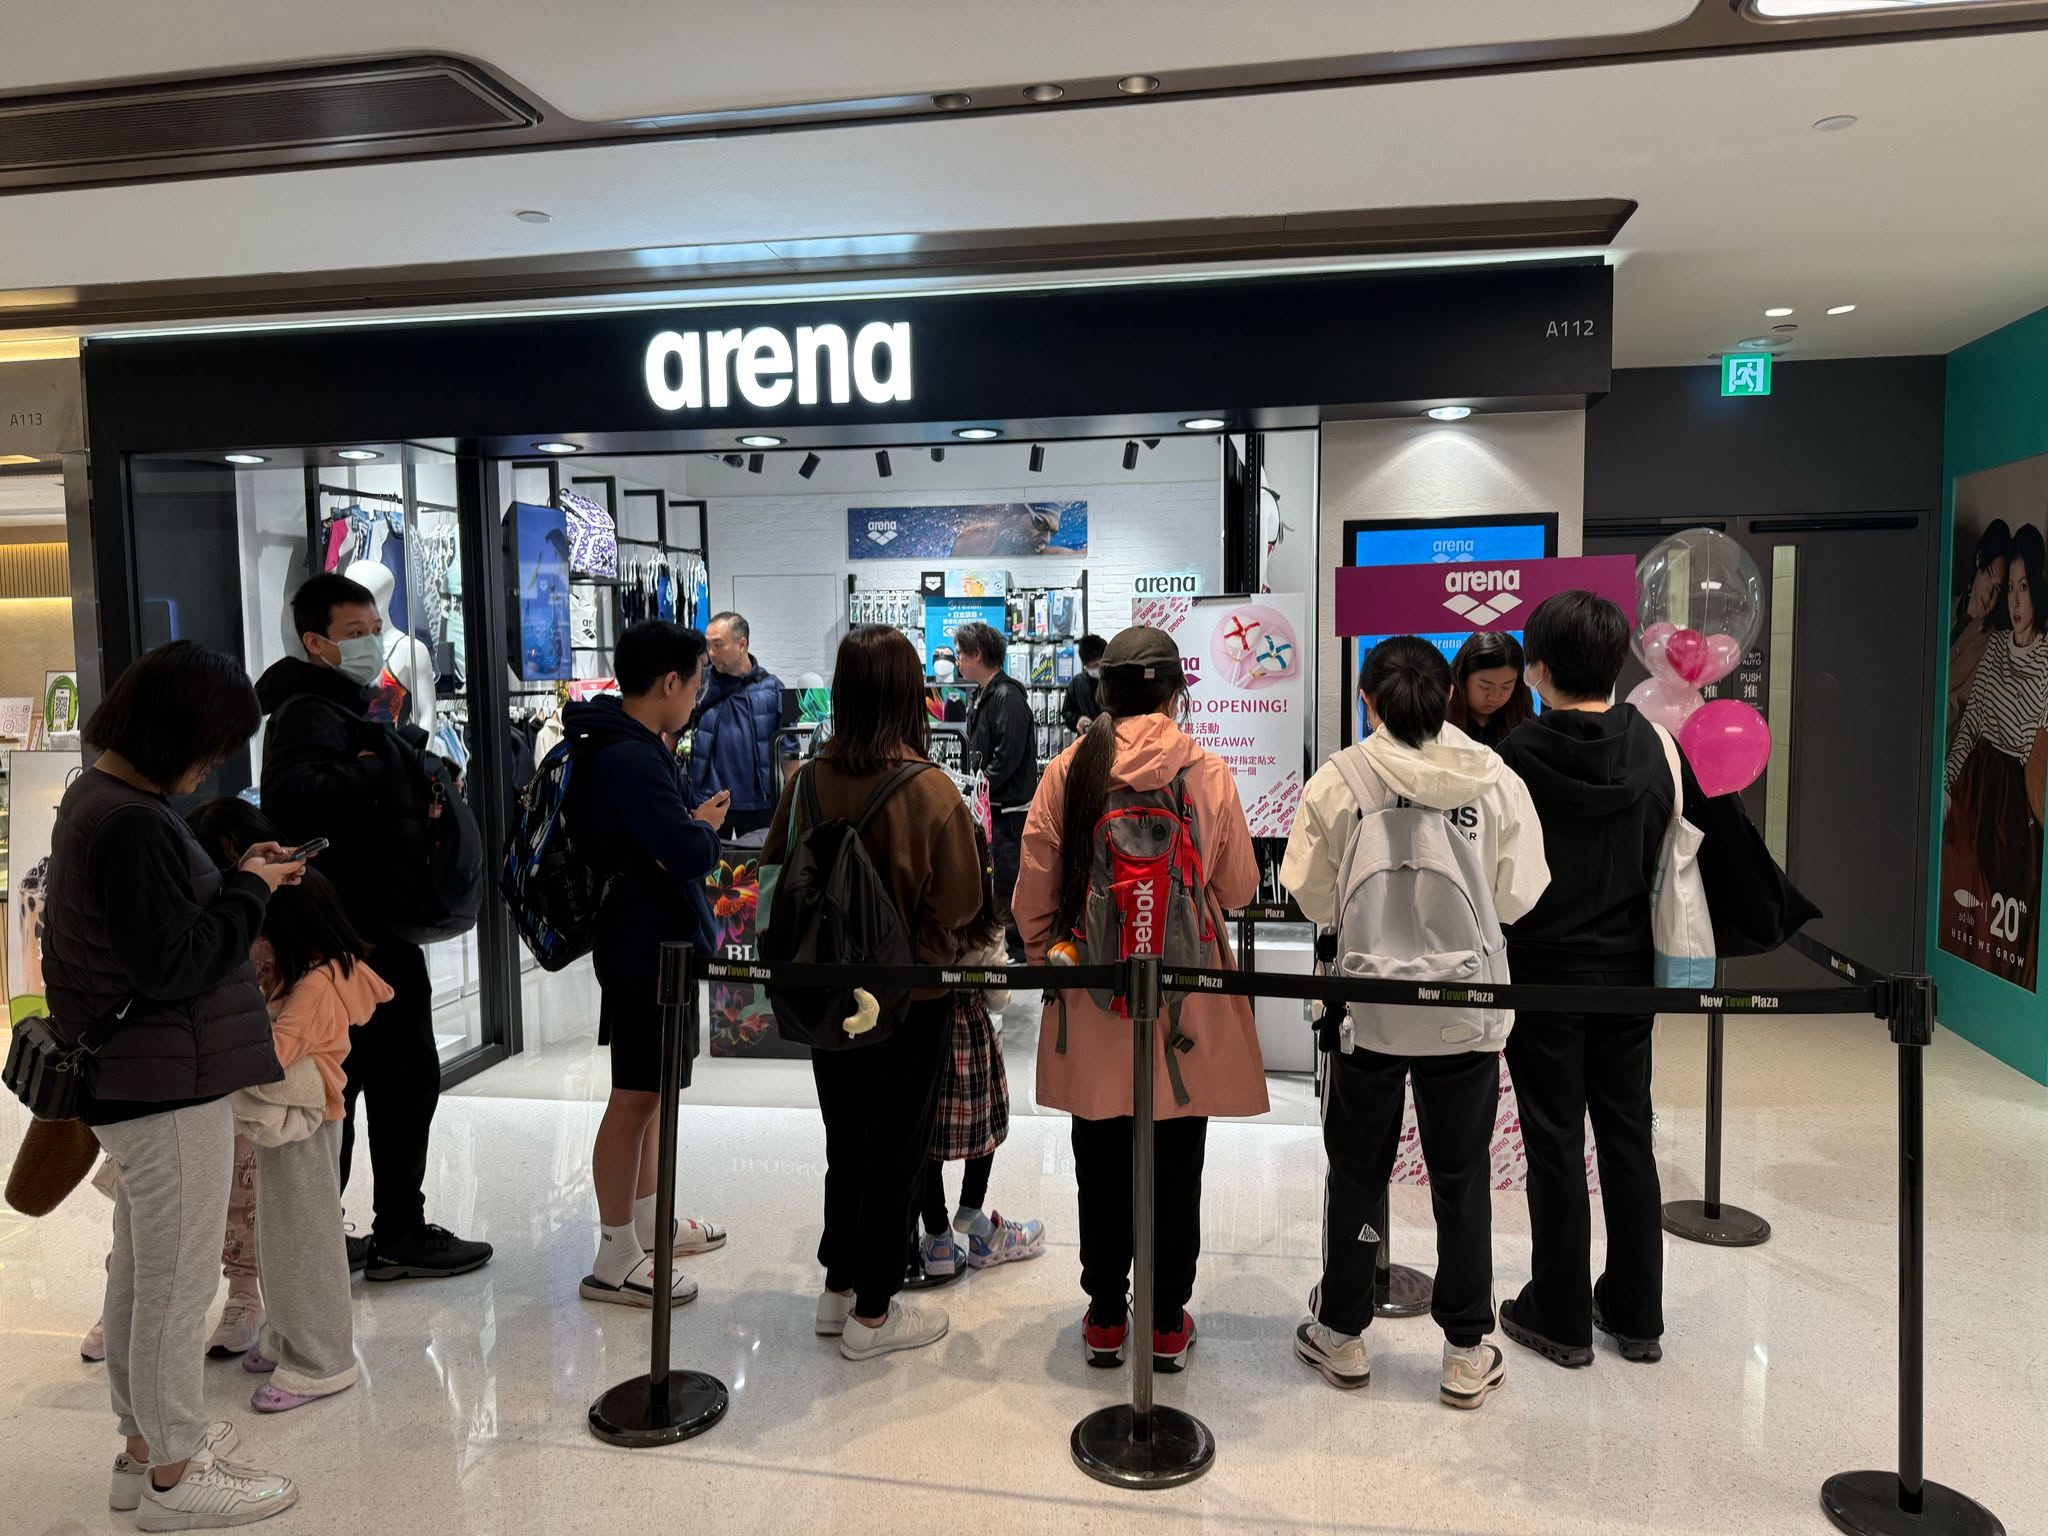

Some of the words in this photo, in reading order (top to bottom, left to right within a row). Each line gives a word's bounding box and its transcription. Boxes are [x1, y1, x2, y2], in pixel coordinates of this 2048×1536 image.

[1546, 320, 1594, 338] A112
[645, 321, 911, 410] arena
[10, 412, 43, 427] A113
[868, 520, 896, 531] arena
[1433, 539, 1474, 552] arena
[1134, 576, 1196, 593] arena
[1445, 569, 1520, 592] arena
[1167, 614, 1186, 633] arena
[1740, 673, 1761, 682] PUSH
[1744, 684, 1758, 698] 推
[1207, 699, 1288, 713] OPENING!
[1194, 737, 1256, 747] GIVEAWAY
[1132, 880, 1154, 953] eebok
[1951, 928, 1973, 945] HERE
[1978, 939, 1990, 953] WE
[1996, 947, 2025, 967] GROW
